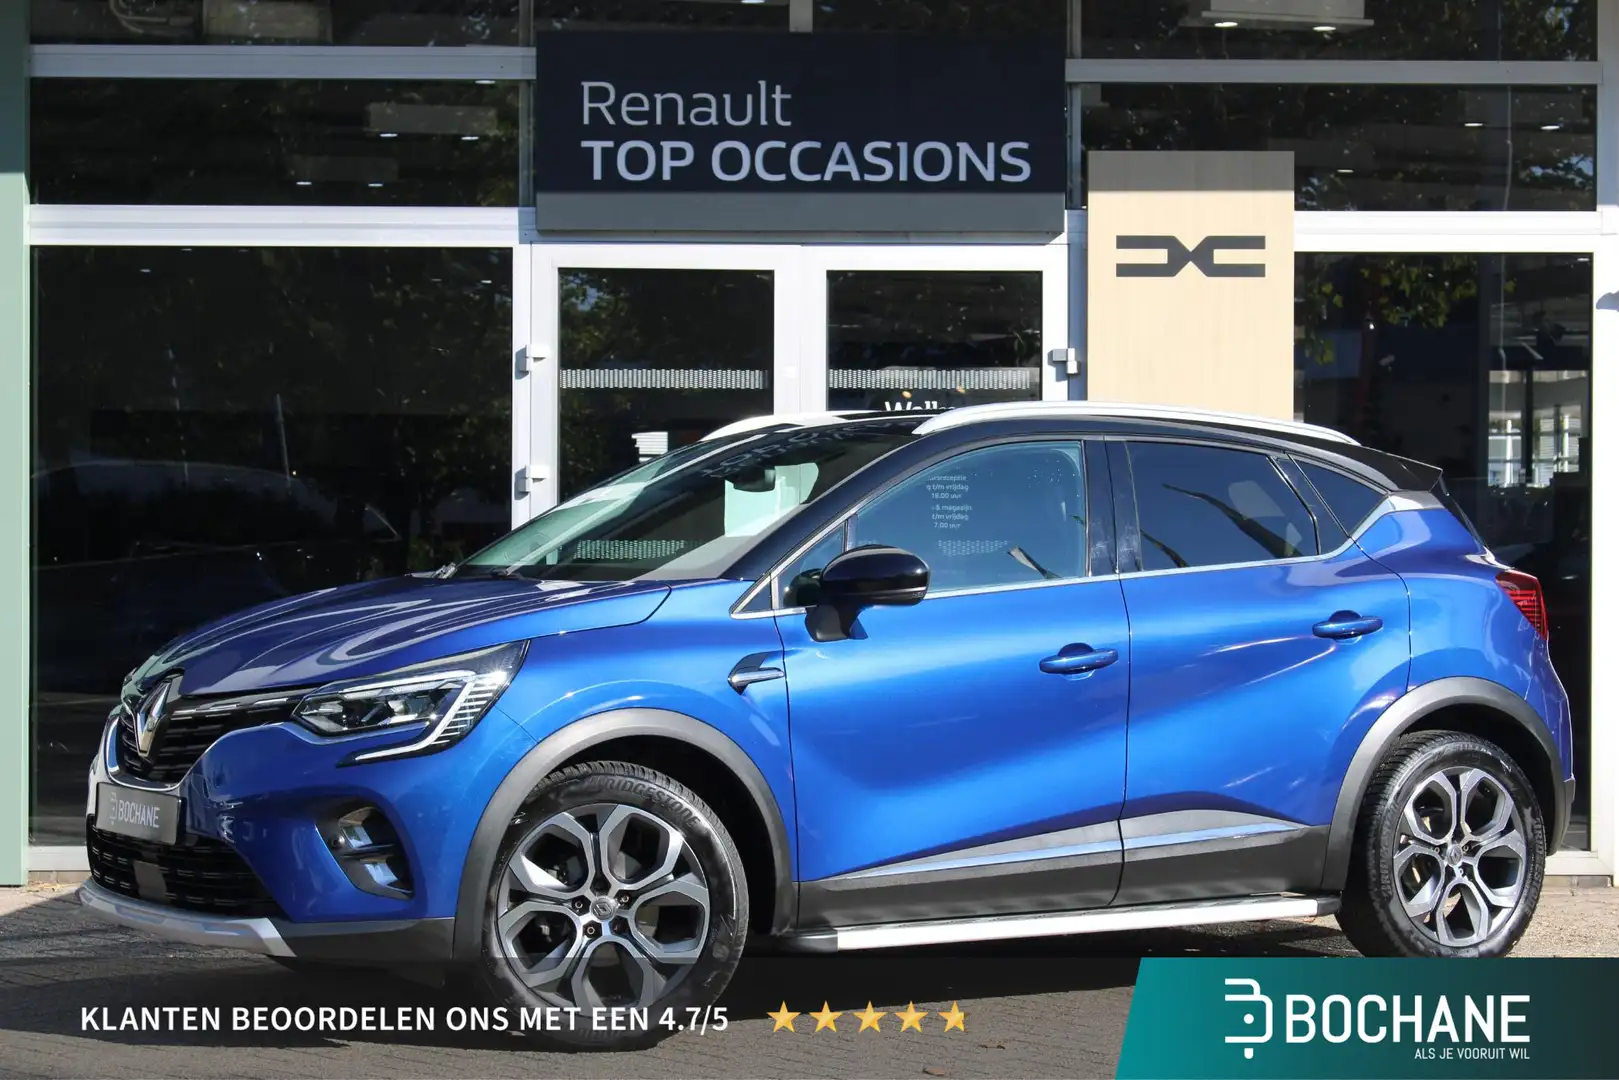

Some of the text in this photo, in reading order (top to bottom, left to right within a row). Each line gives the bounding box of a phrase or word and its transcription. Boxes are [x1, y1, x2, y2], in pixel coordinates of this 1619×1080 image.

[582, 81, 791, 126] Renault
[581, 141, 1030, 182] TOP OCCASIONS
[946, 484, 969, 492] vrijdag
[946, 513, 969, 521] vrijdag
[119, 800, 160, 828] BOCHANE
